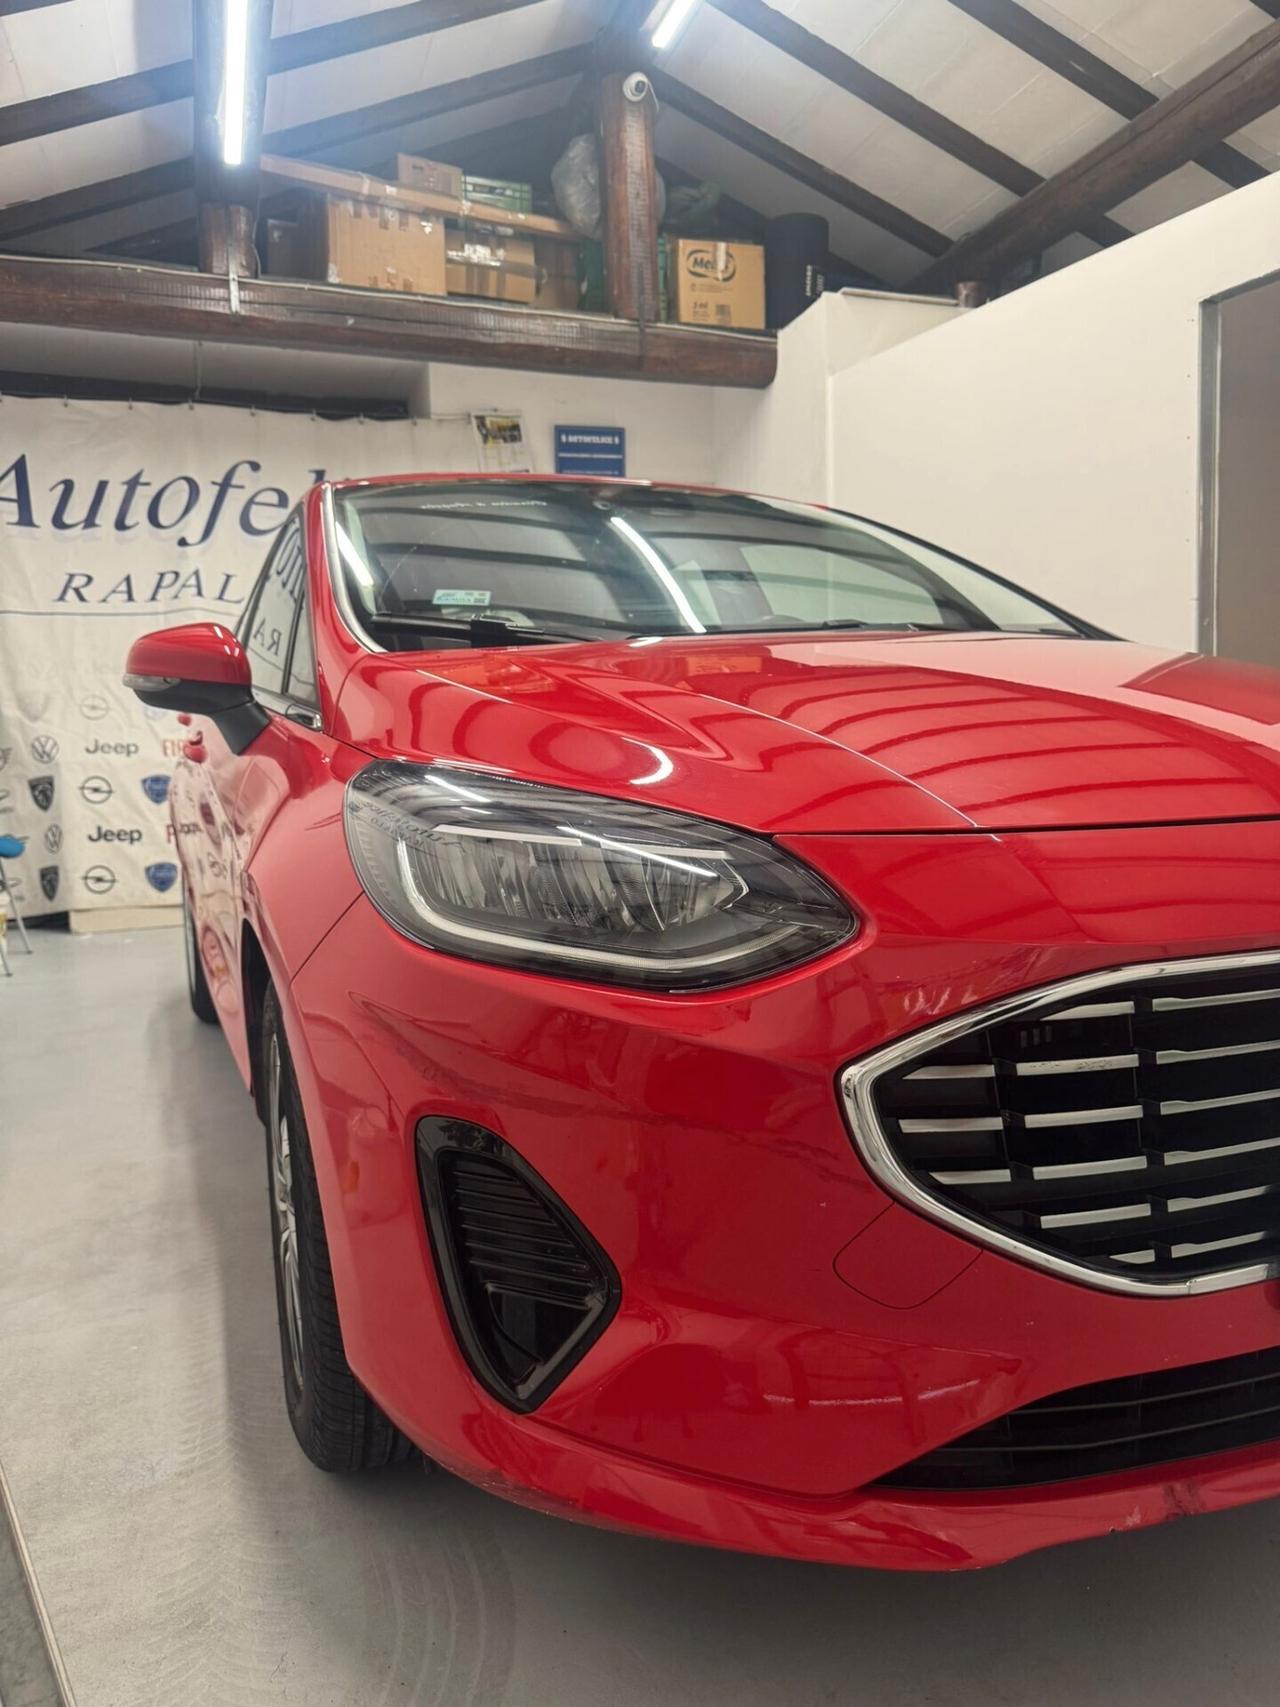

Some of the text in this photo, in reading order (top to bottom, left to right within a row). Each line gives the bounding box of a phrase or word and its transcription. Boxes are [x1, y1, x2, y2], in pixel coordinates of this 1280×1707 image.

[0, 454, 327, 547] Autofe
[52, 568, 245, 603] RAPAL
[84, 739, 139, 757] Jeep
[87, 825, 142, 845] Jeep
